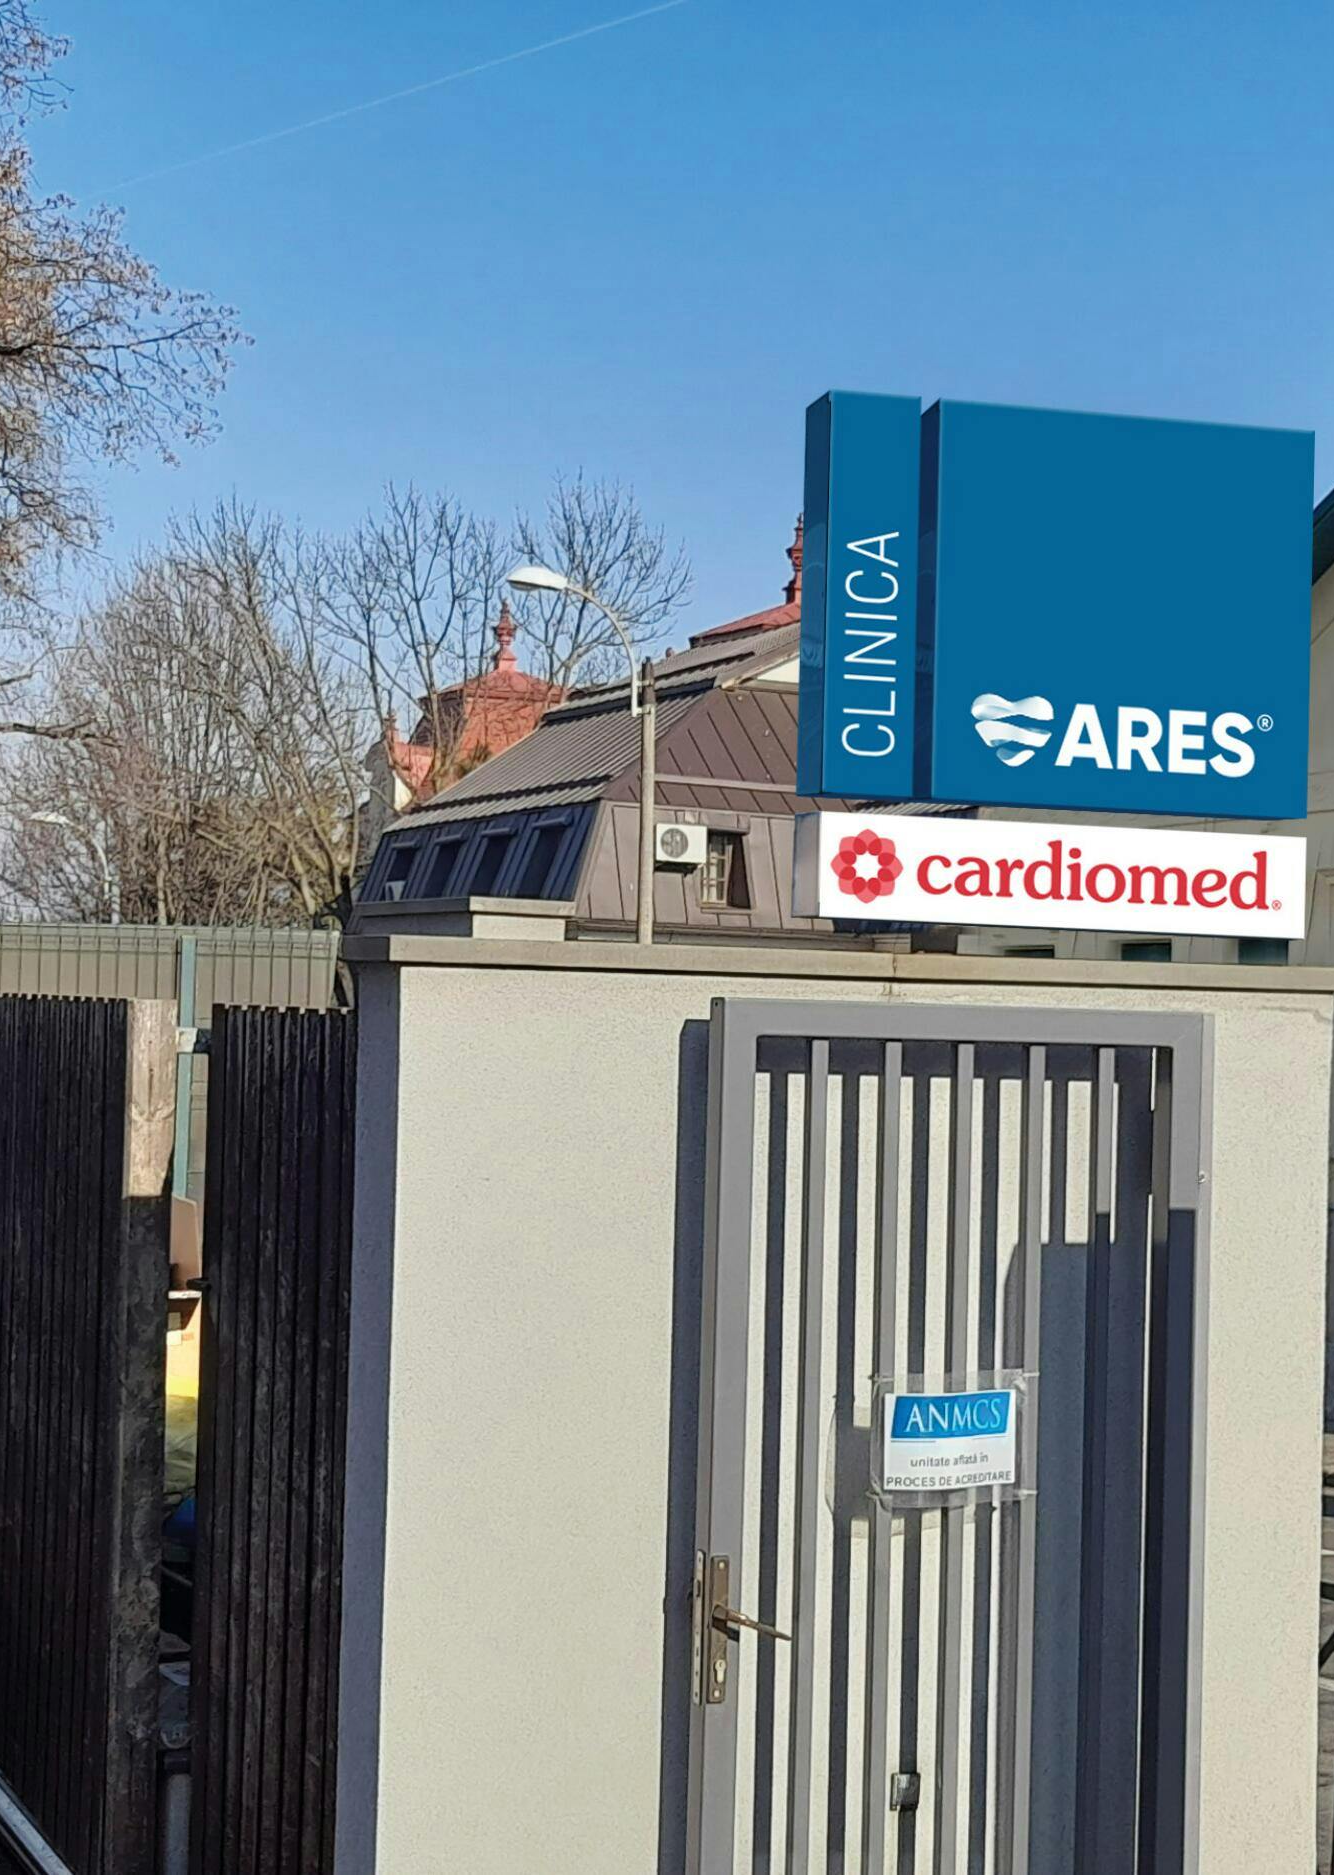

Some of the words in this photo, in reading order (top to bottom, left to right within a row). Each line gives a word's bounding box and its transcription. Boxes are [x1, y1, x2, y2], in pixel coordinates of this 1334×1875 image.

[841, 531, 899, 758] CLINICA
[904, 1398, 1001, 1433] ANMCS
[910, 1456, 950, 1468] unitate
[886, 1475, 936, 1488] PROCES
[939, 1475, 952, 1487] DE
[954, 1470, 1012, 1485] ACREDITARE
